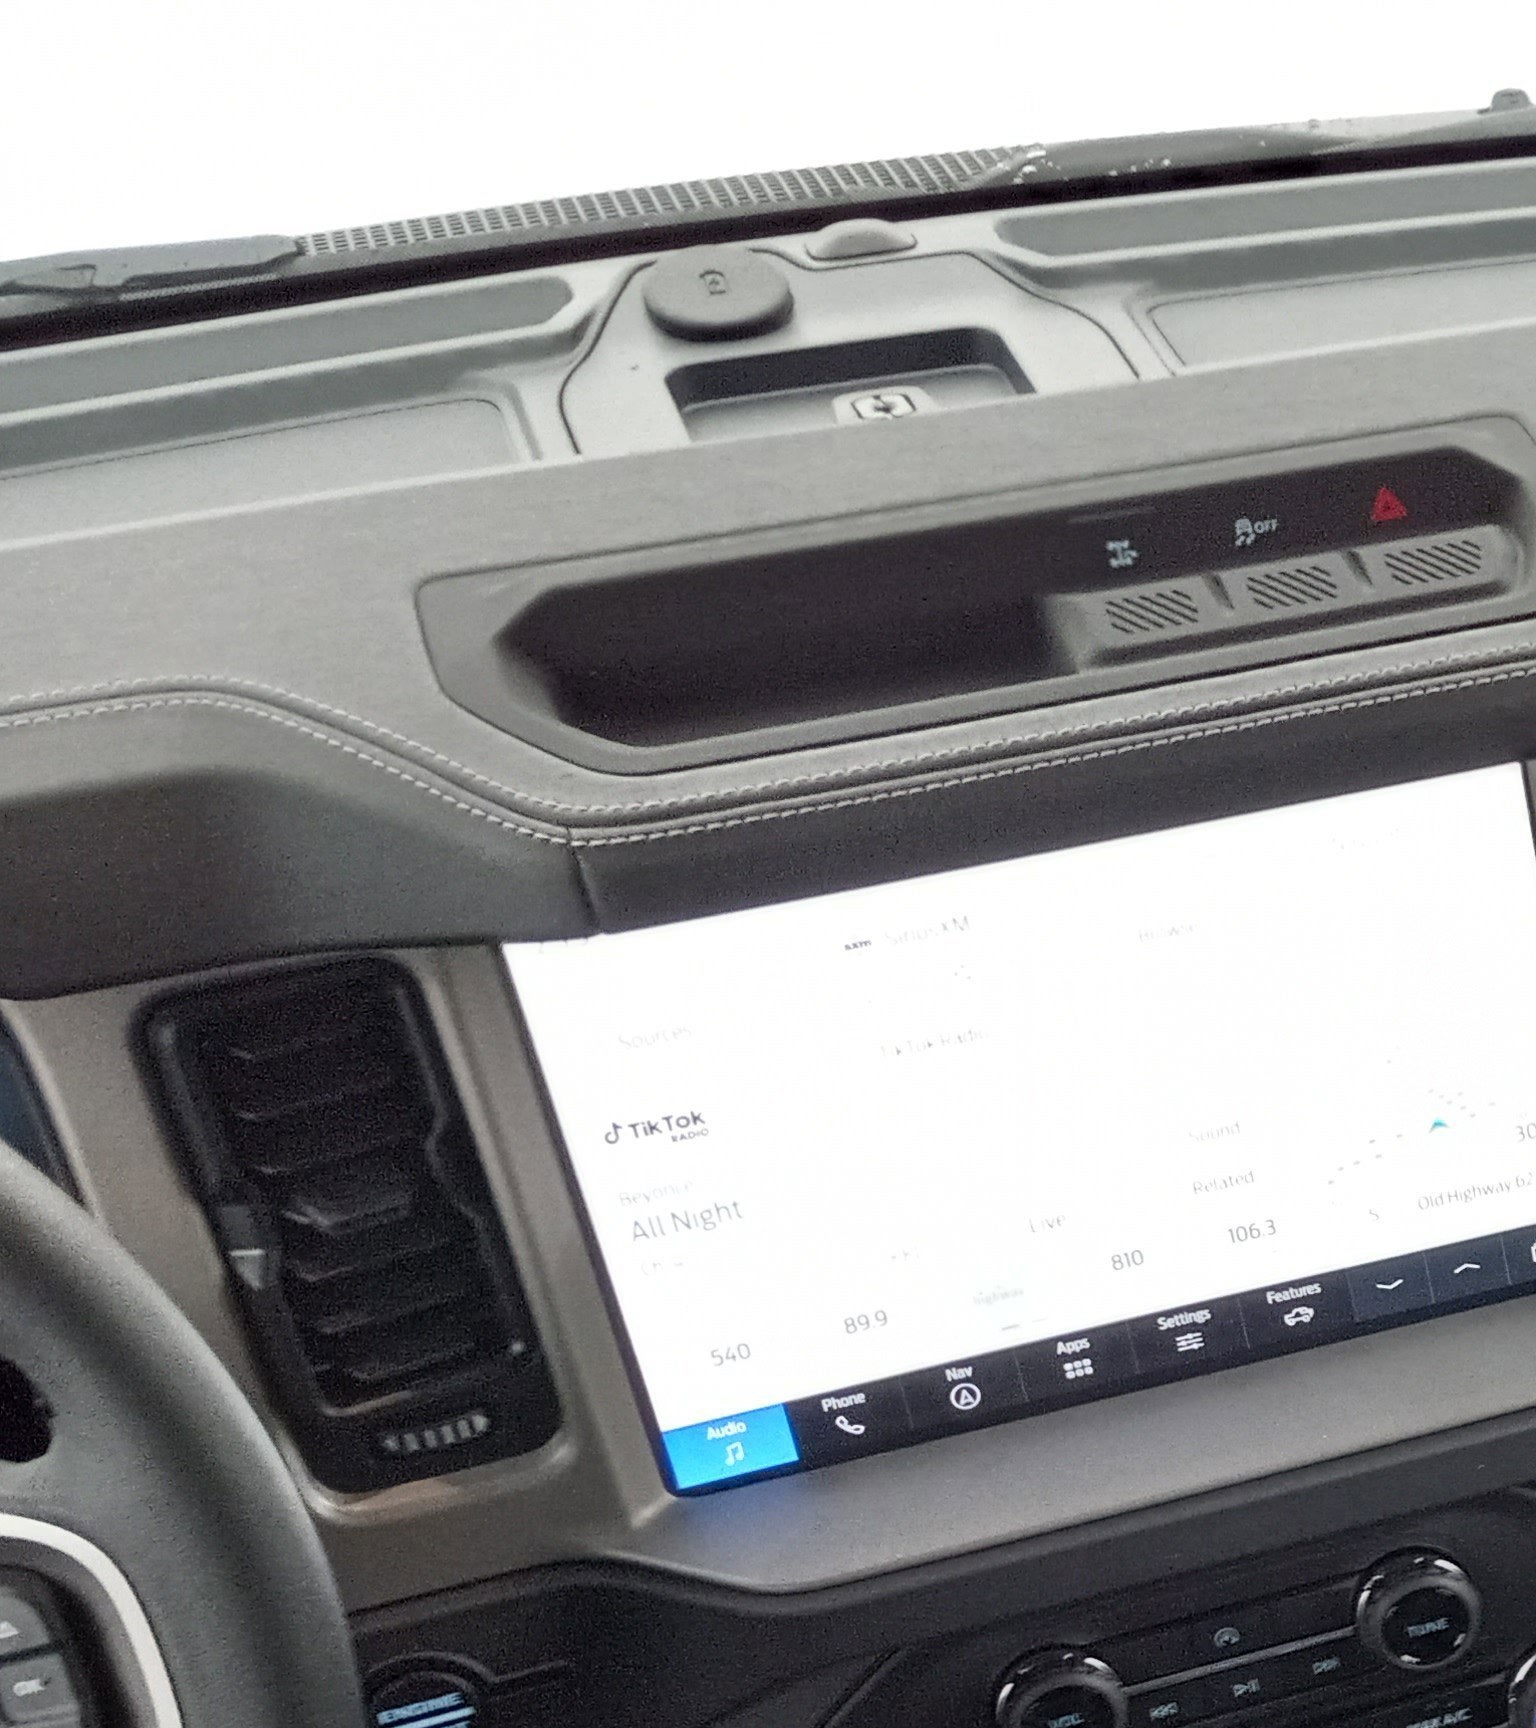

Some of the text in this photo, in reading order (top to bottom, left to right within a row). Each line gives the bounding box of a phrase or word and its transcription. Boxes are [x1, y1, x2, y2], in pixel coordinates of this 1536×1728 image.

[1253, 517, 1279, 535] OFF
[627, 1109, 706, 1141] TikTok
[671, 1126, 710, 1143] RADIO
[1191, 1168, 1256, 1196] Related
[1416, 1190, 1445, 1212] Old
[1447, 1178, 1513, 1206] Highway
[630, 1199, 745, 1243] All Night
[1028, 1213, 1068, 1234] Live
[1227, 1219, 1277, 1245] 106.3
[1110, 1248, 1145, 1272] 810
[1265, 1281, 1322, 1305] Features
[842, 1308, 889, 1335] 89.9
[1156, 1307, 1212, 1331] Settings
[710, 1342, 752, 1367] 540
[1056, 1336, 1091, 1357] Apps
[945, 1365, 973, 1382] Nav
[821, 1391, 866, 1412] Phone
[706, 1421, 747, 1440] Audio
[1407, 1616, 1450, 1638] TUNE
[1443, 1708, 1474, 1727] A/C
